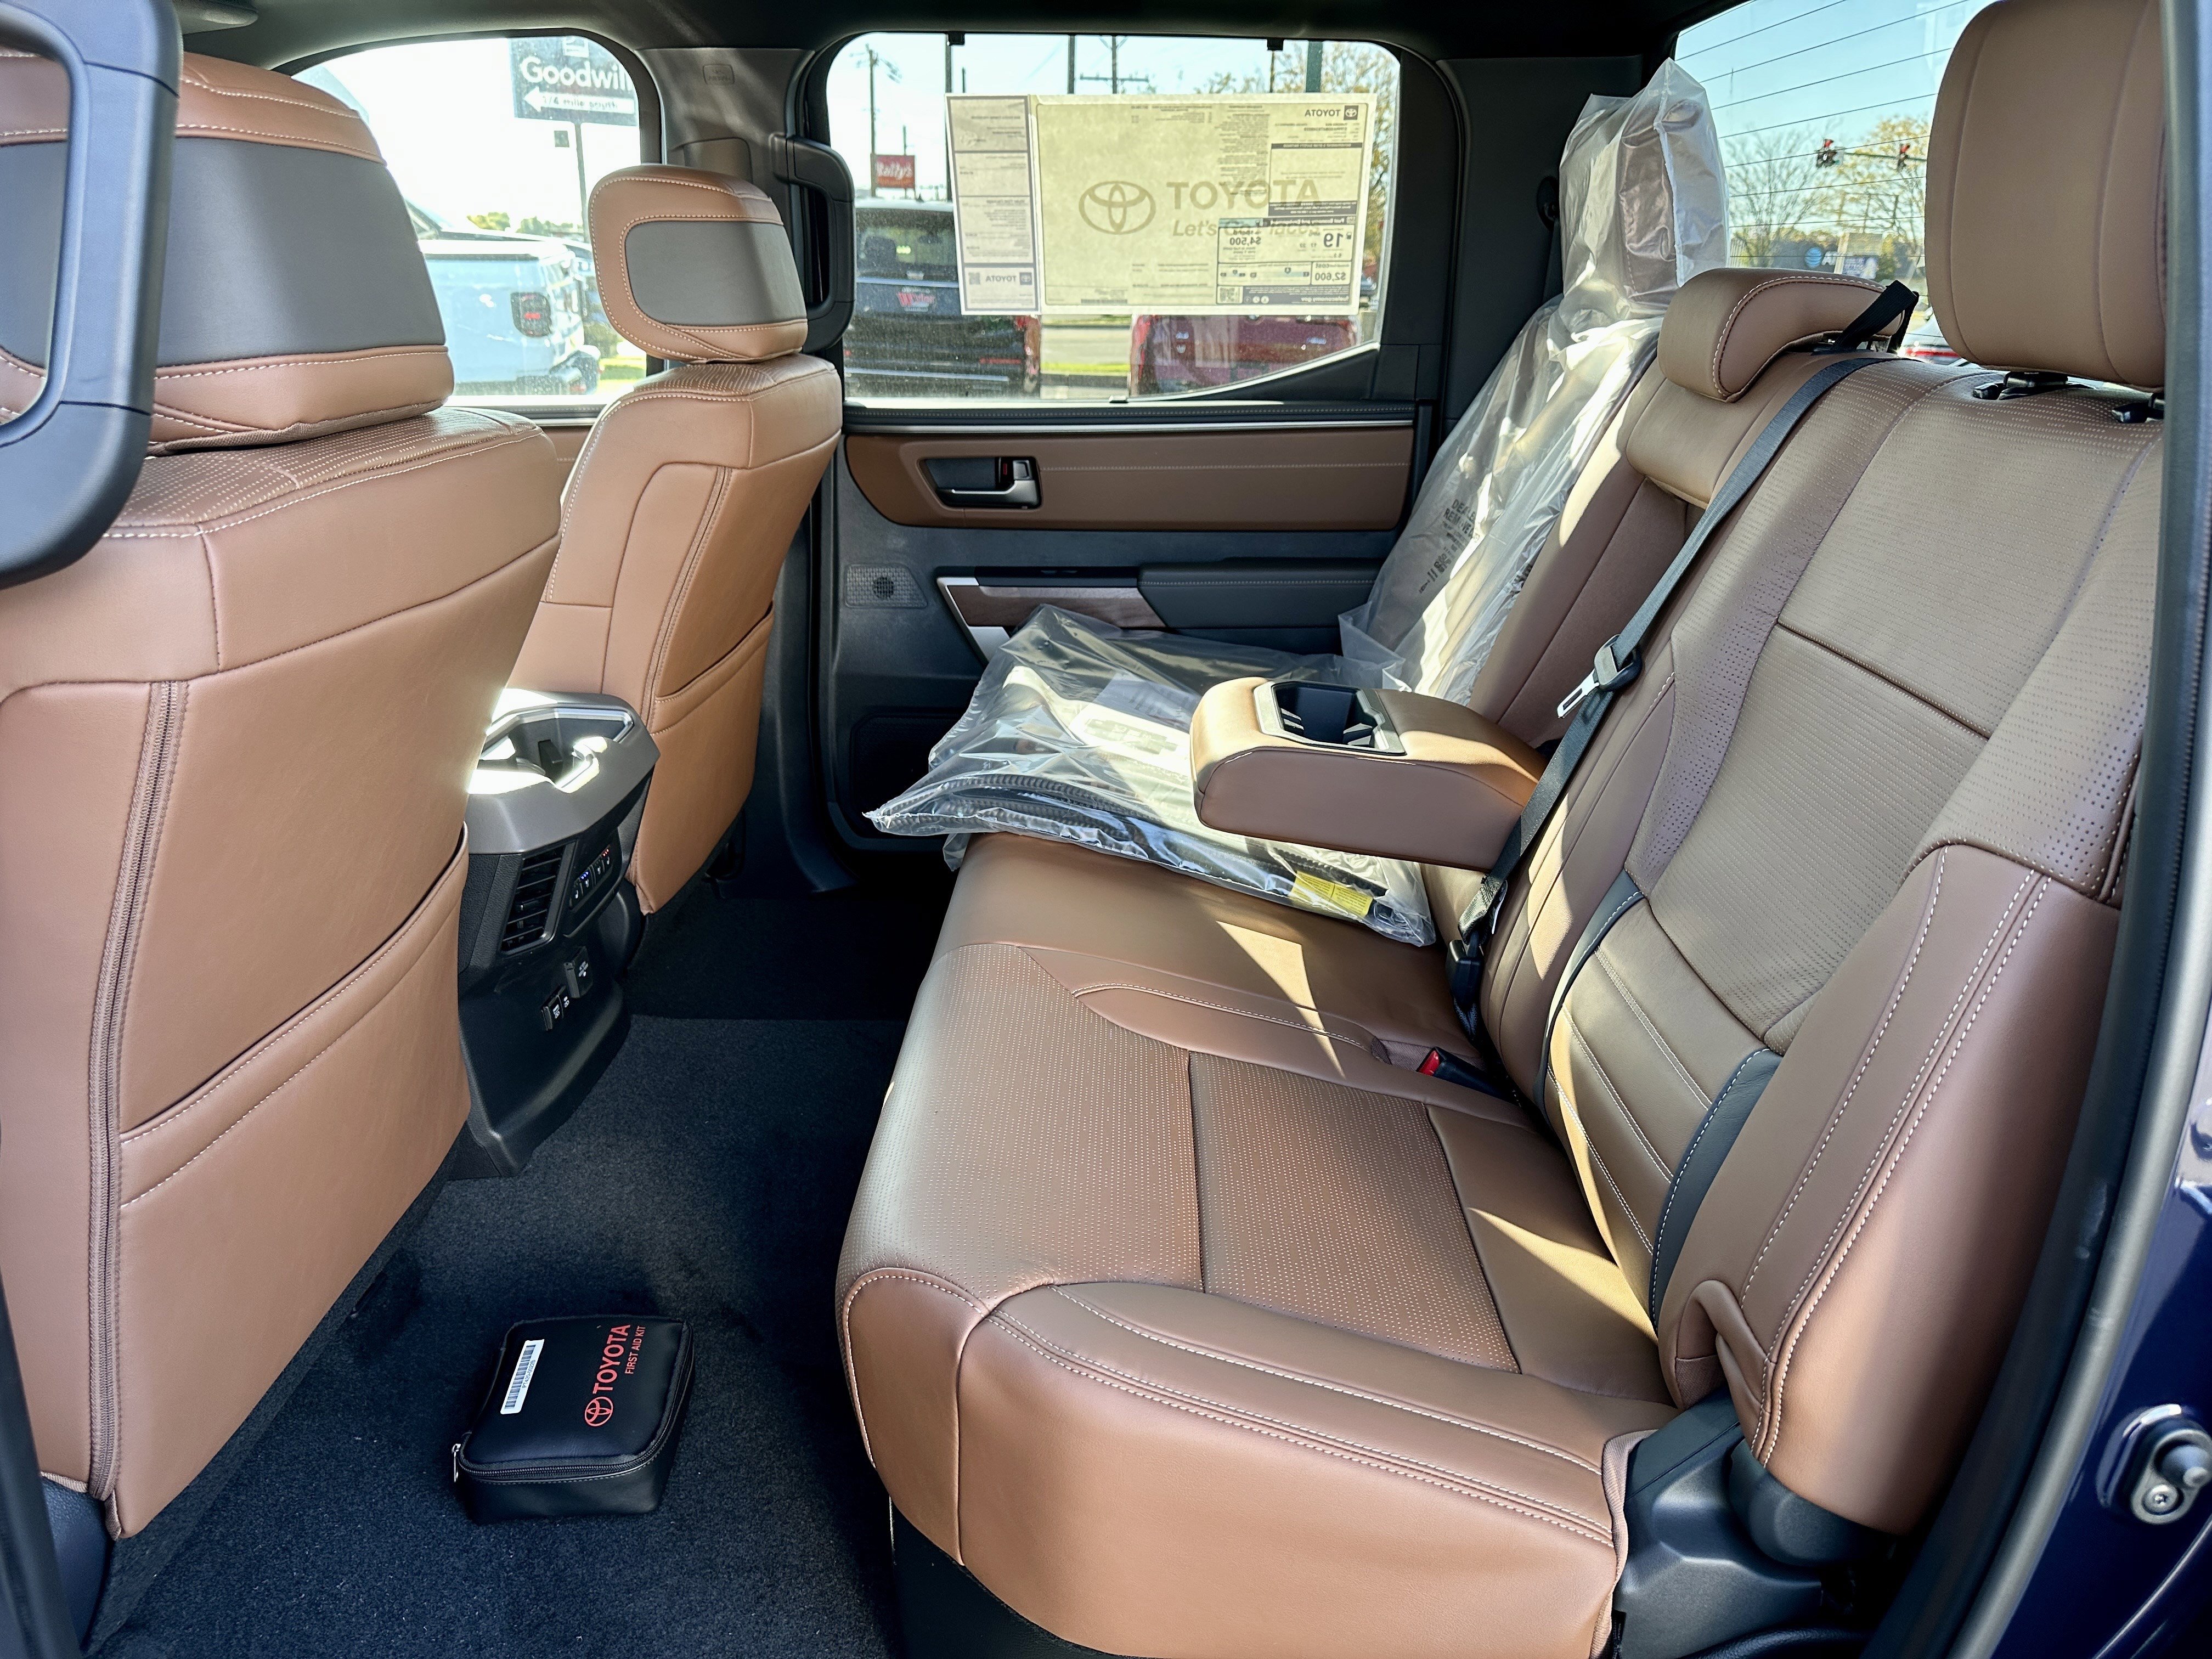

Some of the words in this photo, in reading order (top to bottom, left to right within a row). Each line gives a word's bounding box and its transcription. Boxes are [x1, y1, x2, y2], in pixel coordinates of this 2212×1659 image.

[1166, 179, 1320, 210] TOYOTA
[1173, 219, 1217, 236] Let's
[635, 1325, 646, 1336] KIT
[631, 1338, 642, 1351] AID
[592, 1324, 630, 1394] TOYOTA
[625, 1352, 638, 1374] FIRST
